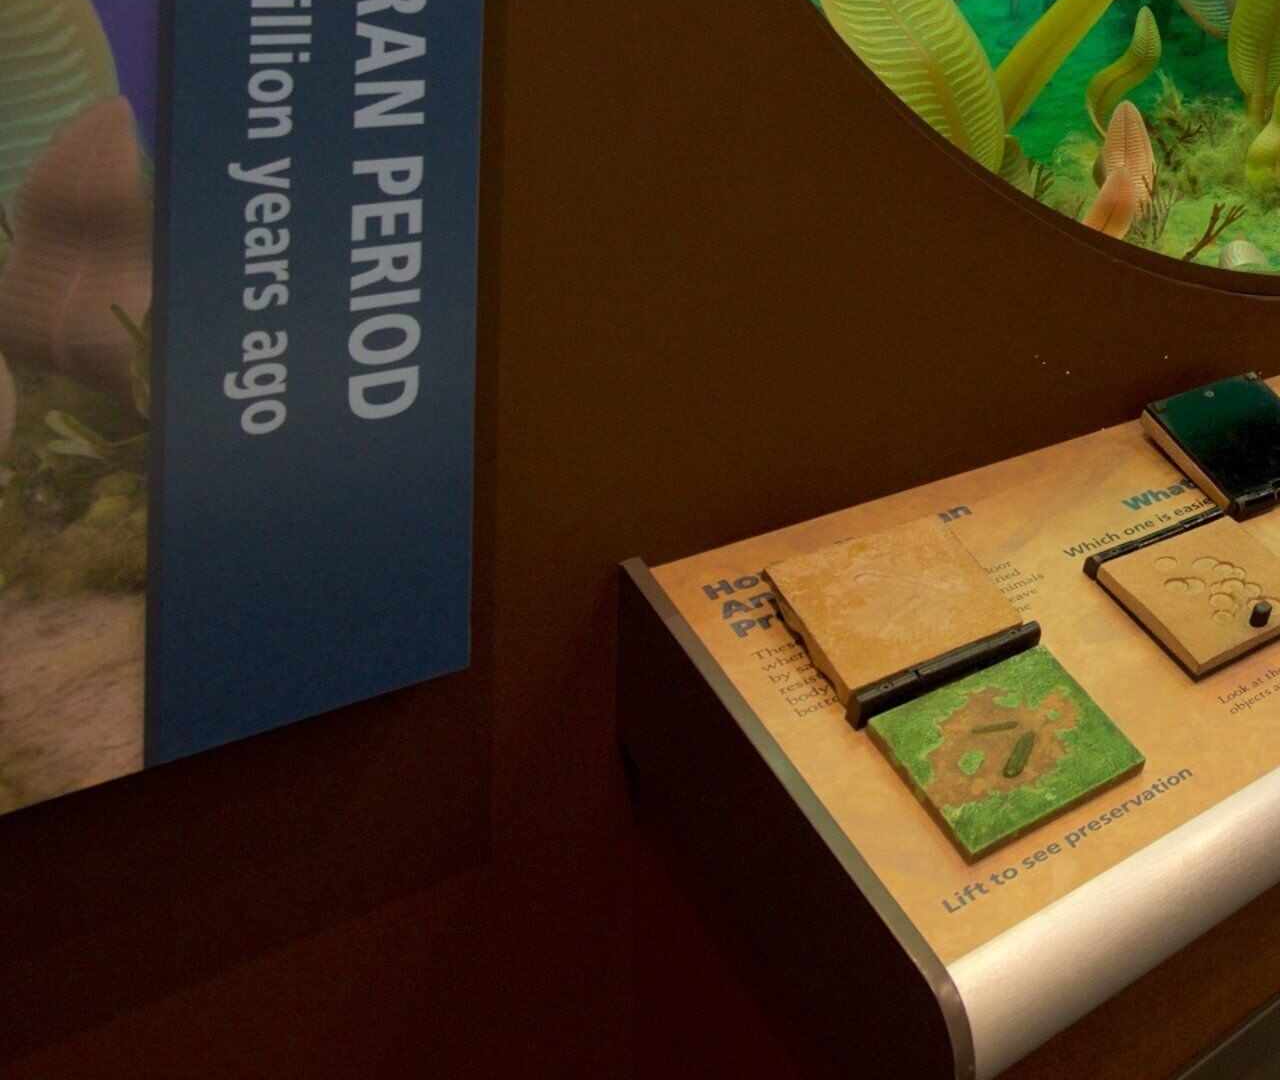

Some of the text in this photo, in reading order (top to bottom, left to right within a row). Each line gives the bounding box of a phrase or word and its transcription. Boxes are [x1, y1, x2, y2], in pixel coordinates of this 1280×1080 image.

[228, 156, 292, 311] years
[347, 154, 425, 422] PERIOD
[223, 328, 289, 436] ago
[1120, 477, 1195, 511] What
[1062, 513, 1172, 558] Which one is
[769, 671, 791, 684] by
[785, 684, 830, 707] body
[1217, 685, 1250, 704] Look
[1252, 677, 1265, 688] at
[1229, 689, 1272, 715] objects
[941, 767, 1194, 914] Lift to see preservation
